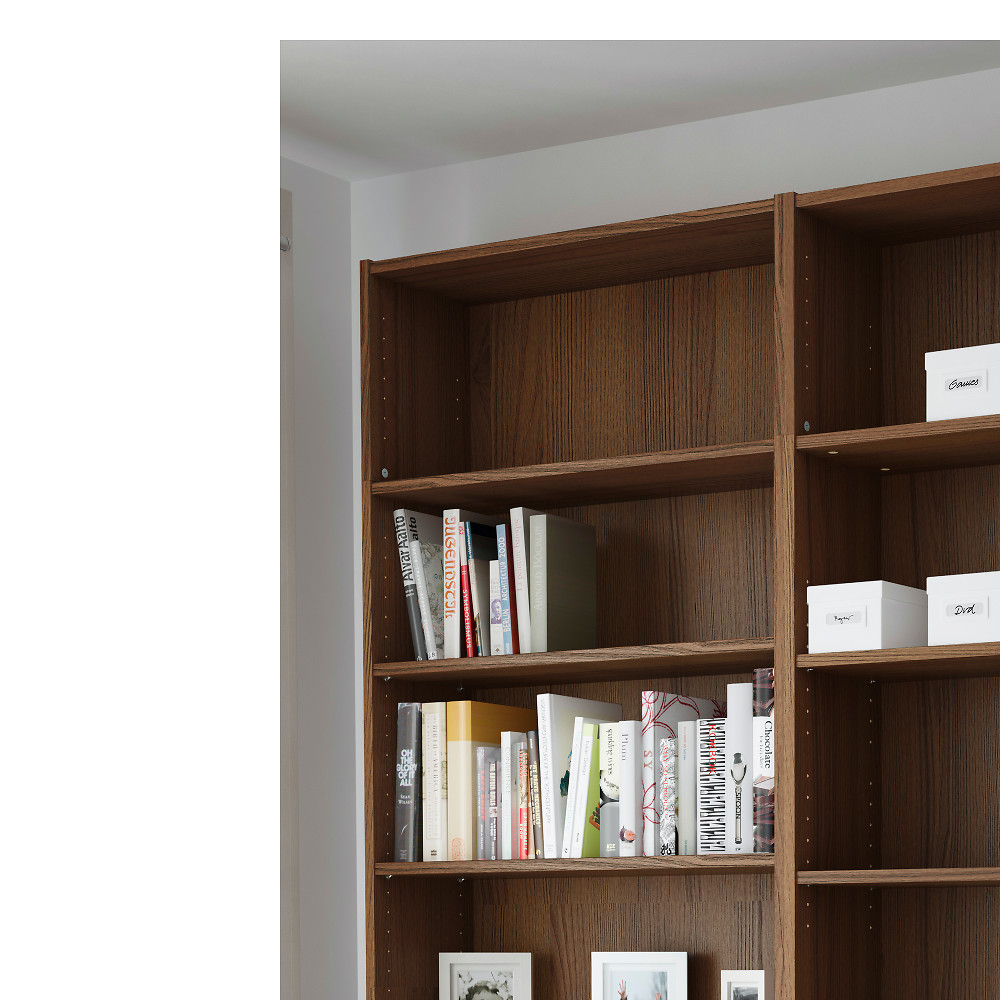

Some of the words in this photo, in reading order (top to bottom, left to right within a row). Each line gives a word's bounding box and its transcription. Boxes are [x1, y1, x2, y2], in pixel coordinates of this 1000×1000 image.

[948, 378, 979, 391] Games
[395, 515, 411, 553] Aalto
[497, 536, 506, 559] 2000
[400, 553, 414, 582] Alvar
[444, 516, 457, 619] JUGENDSTIL
[499, 561, 510, 602] ARCHITEKTUR
[502, 608, 511, 633] BERLIN
[954, 603, 976, 616] Dvd
[401, 749, 413, 757] OH
[620, 734, 629, 762] Plum
[708, 724, 717, 776] KOKBOK
[762, 720, 774, 770] Chocolate
[396, 763, 418, 772] GLORY
[400, 756, 414, 765] THE
[607, 758, 616, 777] wines
[398, 771, 408, 779] OF
[408, 771, 416, 779] IT
[400, 778, 413, 787] ALL
